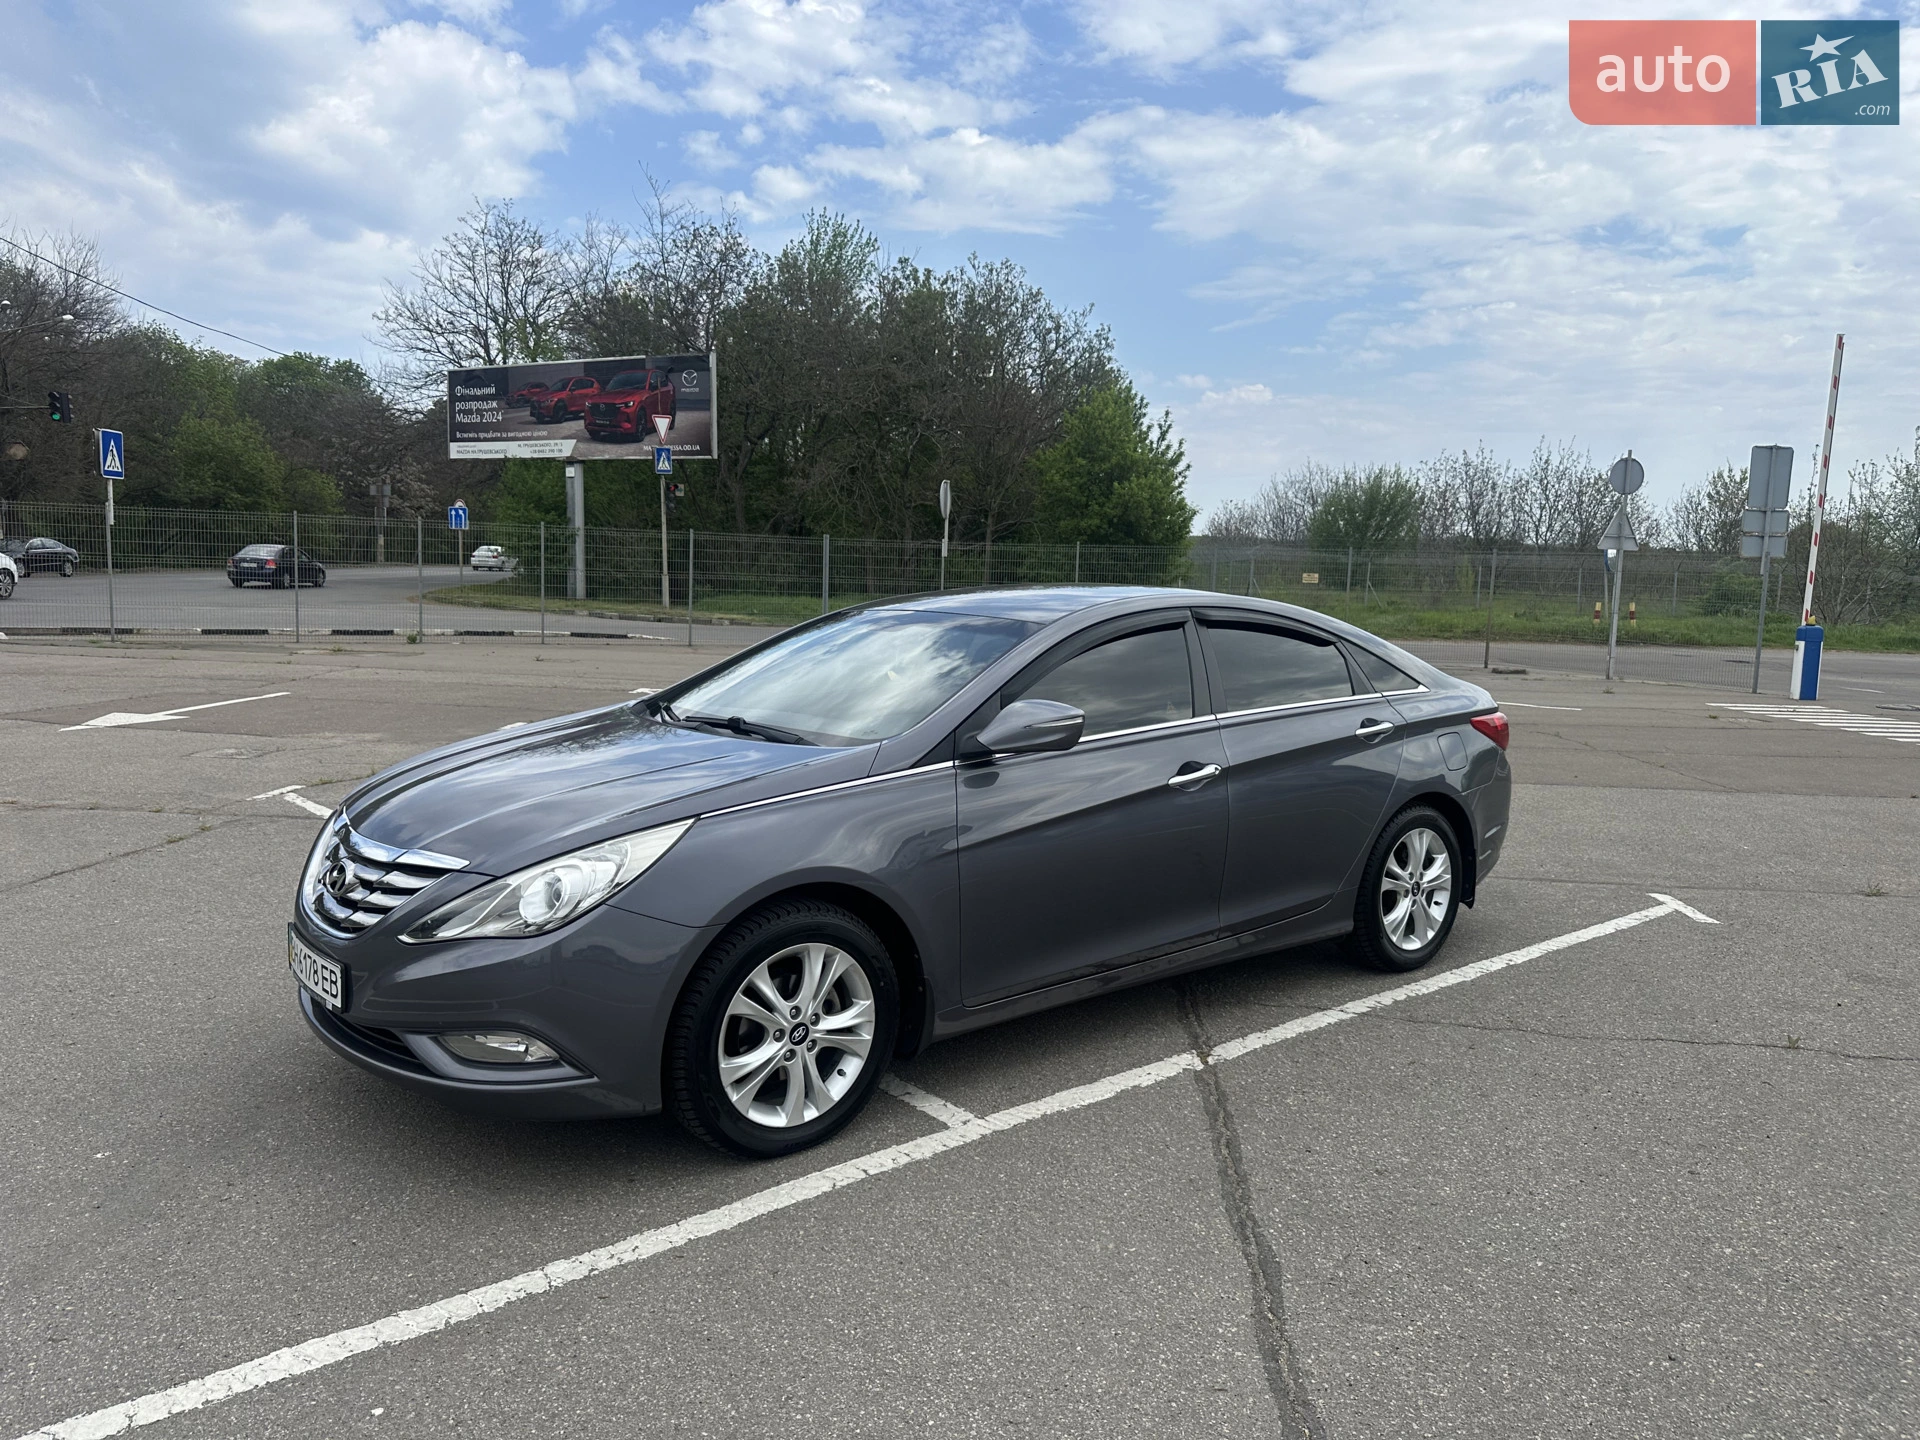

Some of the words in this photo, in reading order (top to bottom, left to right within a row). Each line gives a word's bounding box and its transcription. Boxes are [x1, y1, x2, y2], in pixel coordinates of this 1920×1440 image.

[455, 384, 496, 396] Фінальний
[455, 400, 498, 412] розпродаж
[455, 413, 481, 423] Mazda
